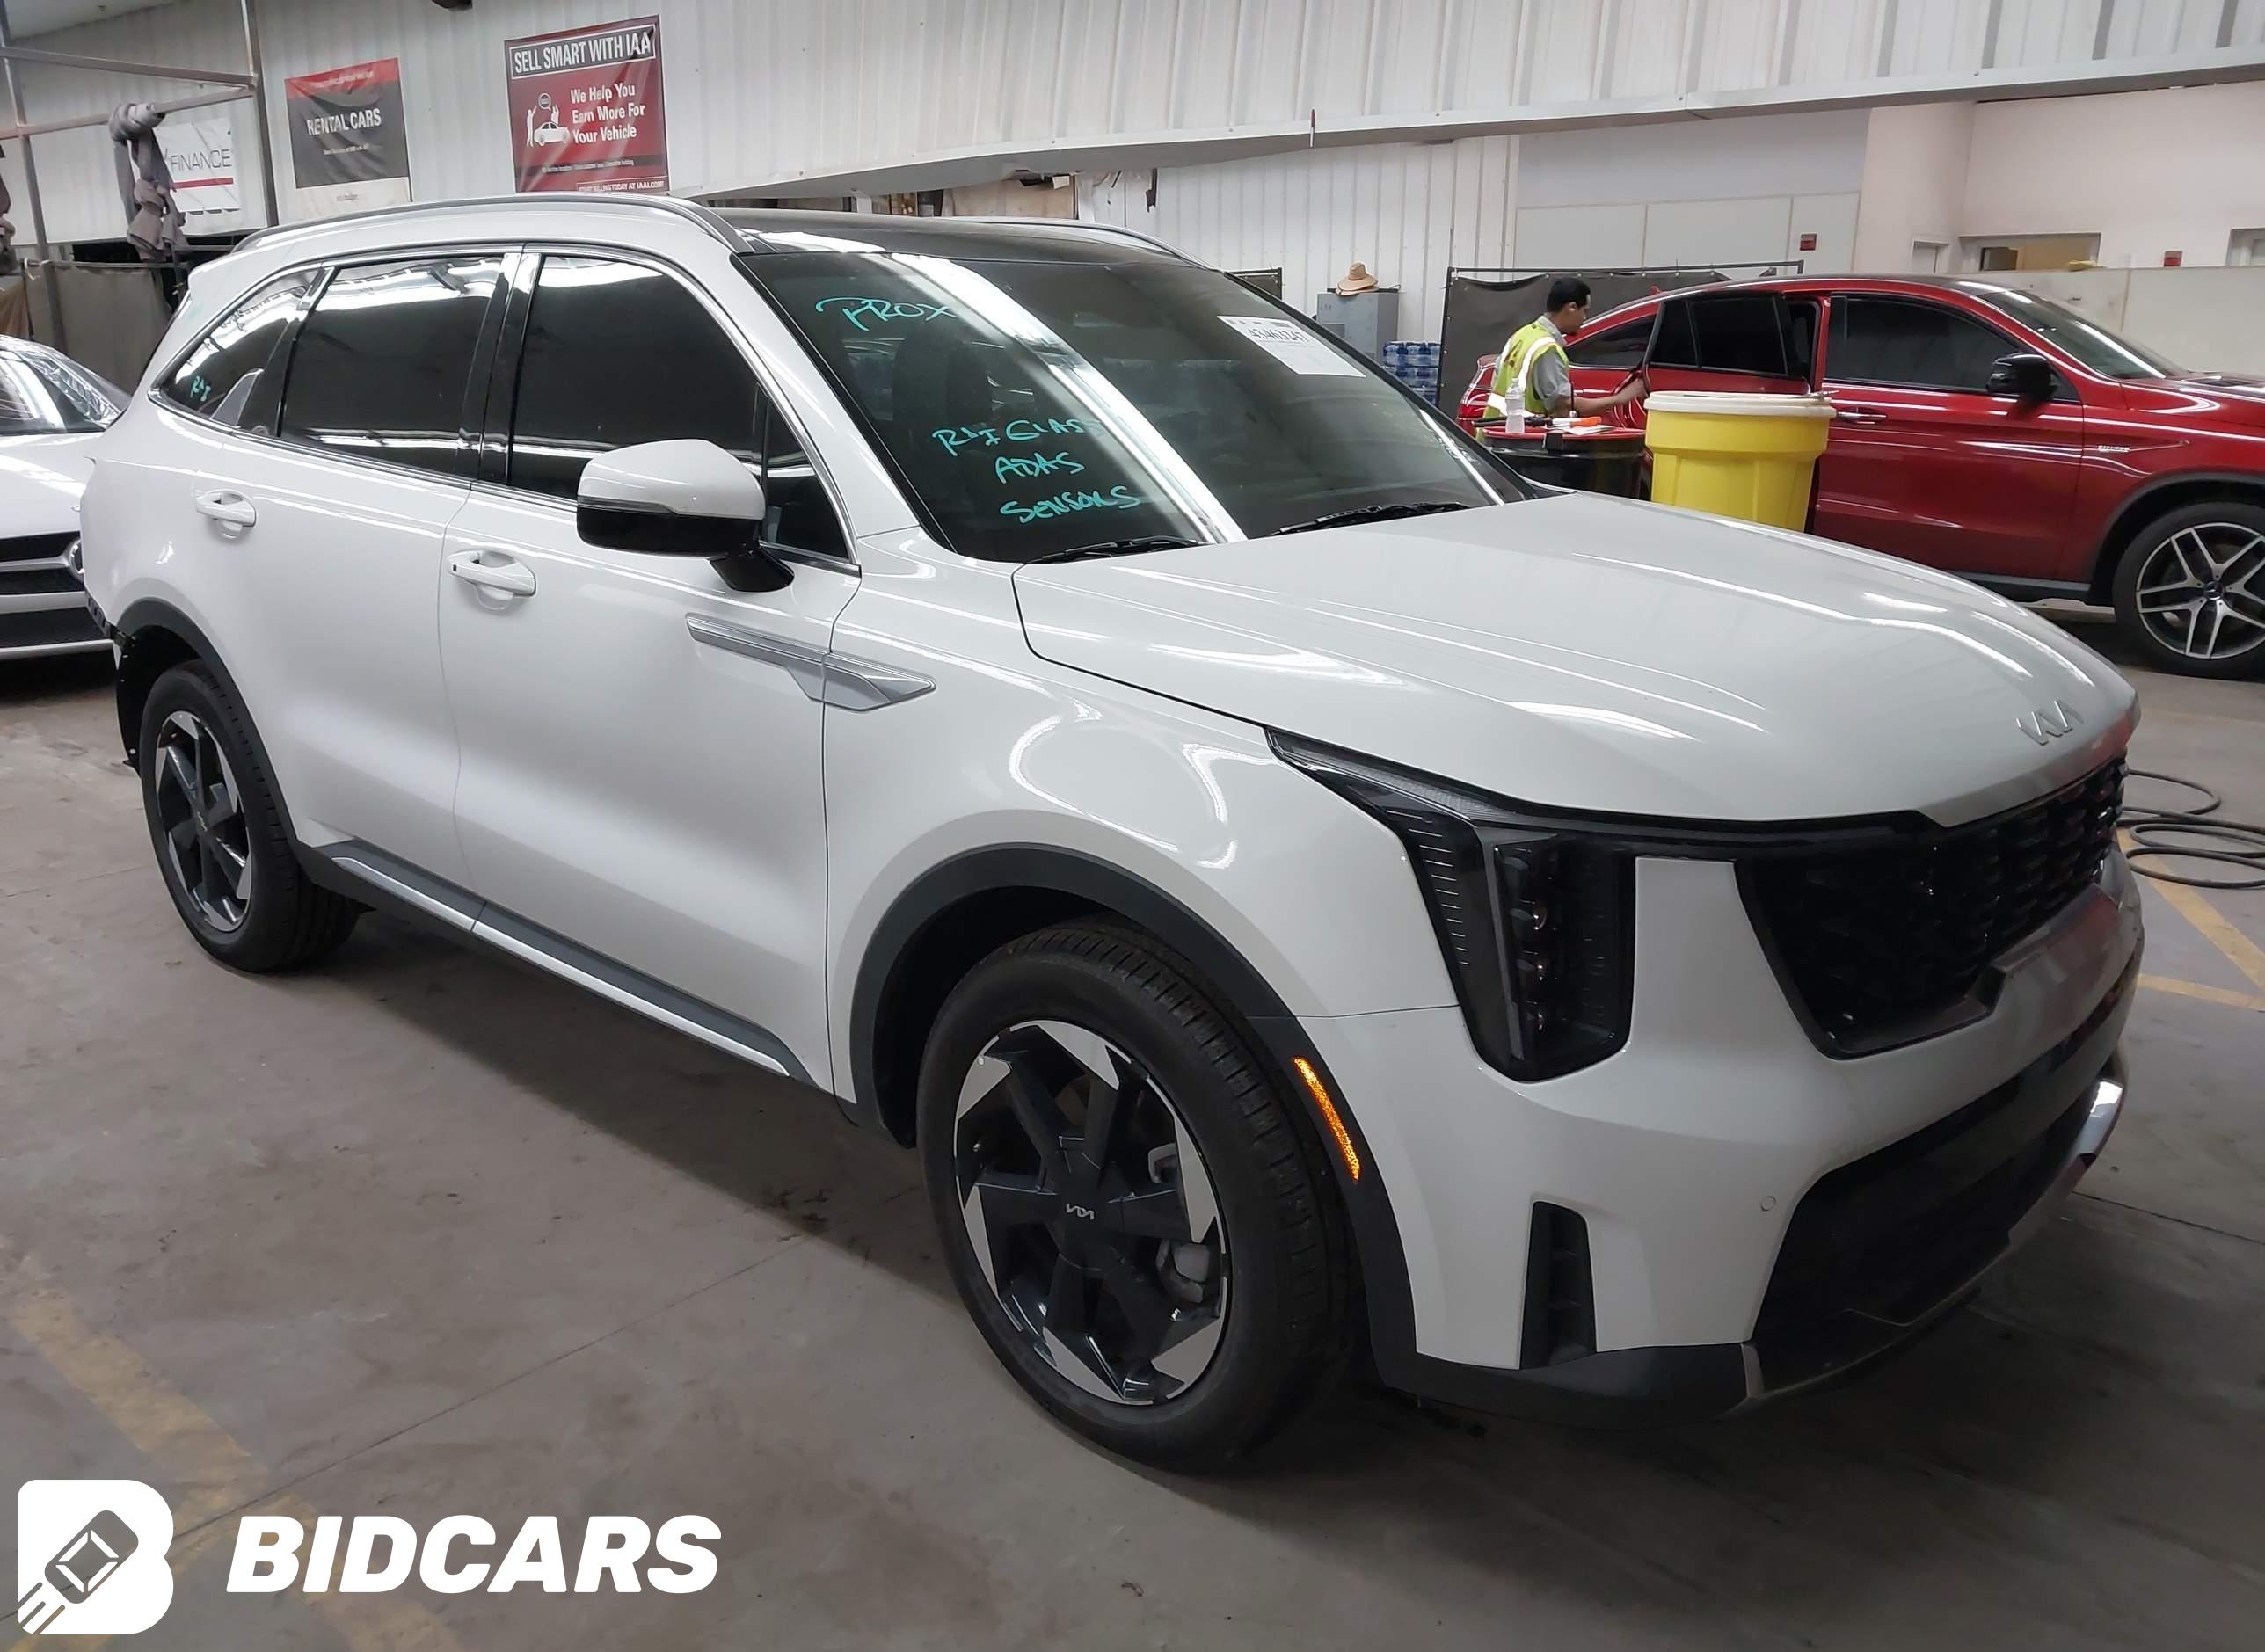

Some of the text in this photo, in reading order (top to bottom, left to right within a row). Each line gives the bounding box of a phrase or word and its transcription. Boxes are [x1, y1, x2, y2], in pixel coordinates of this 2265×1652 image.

[514, 31, 652, 74] SELL SMART WITH IAA
[571, 82, 636, 104] We Help You
[306, 108, 382, 136] RENTAL CARS
[572, 102, 645, 124] Earn More For
[572, 124, 637, 144] Your Vehicle
[171, 149, 232, 172] FINANCE
[816, 297, 957, 331] PROX
[994, 452, 1085, 484] ADAS
